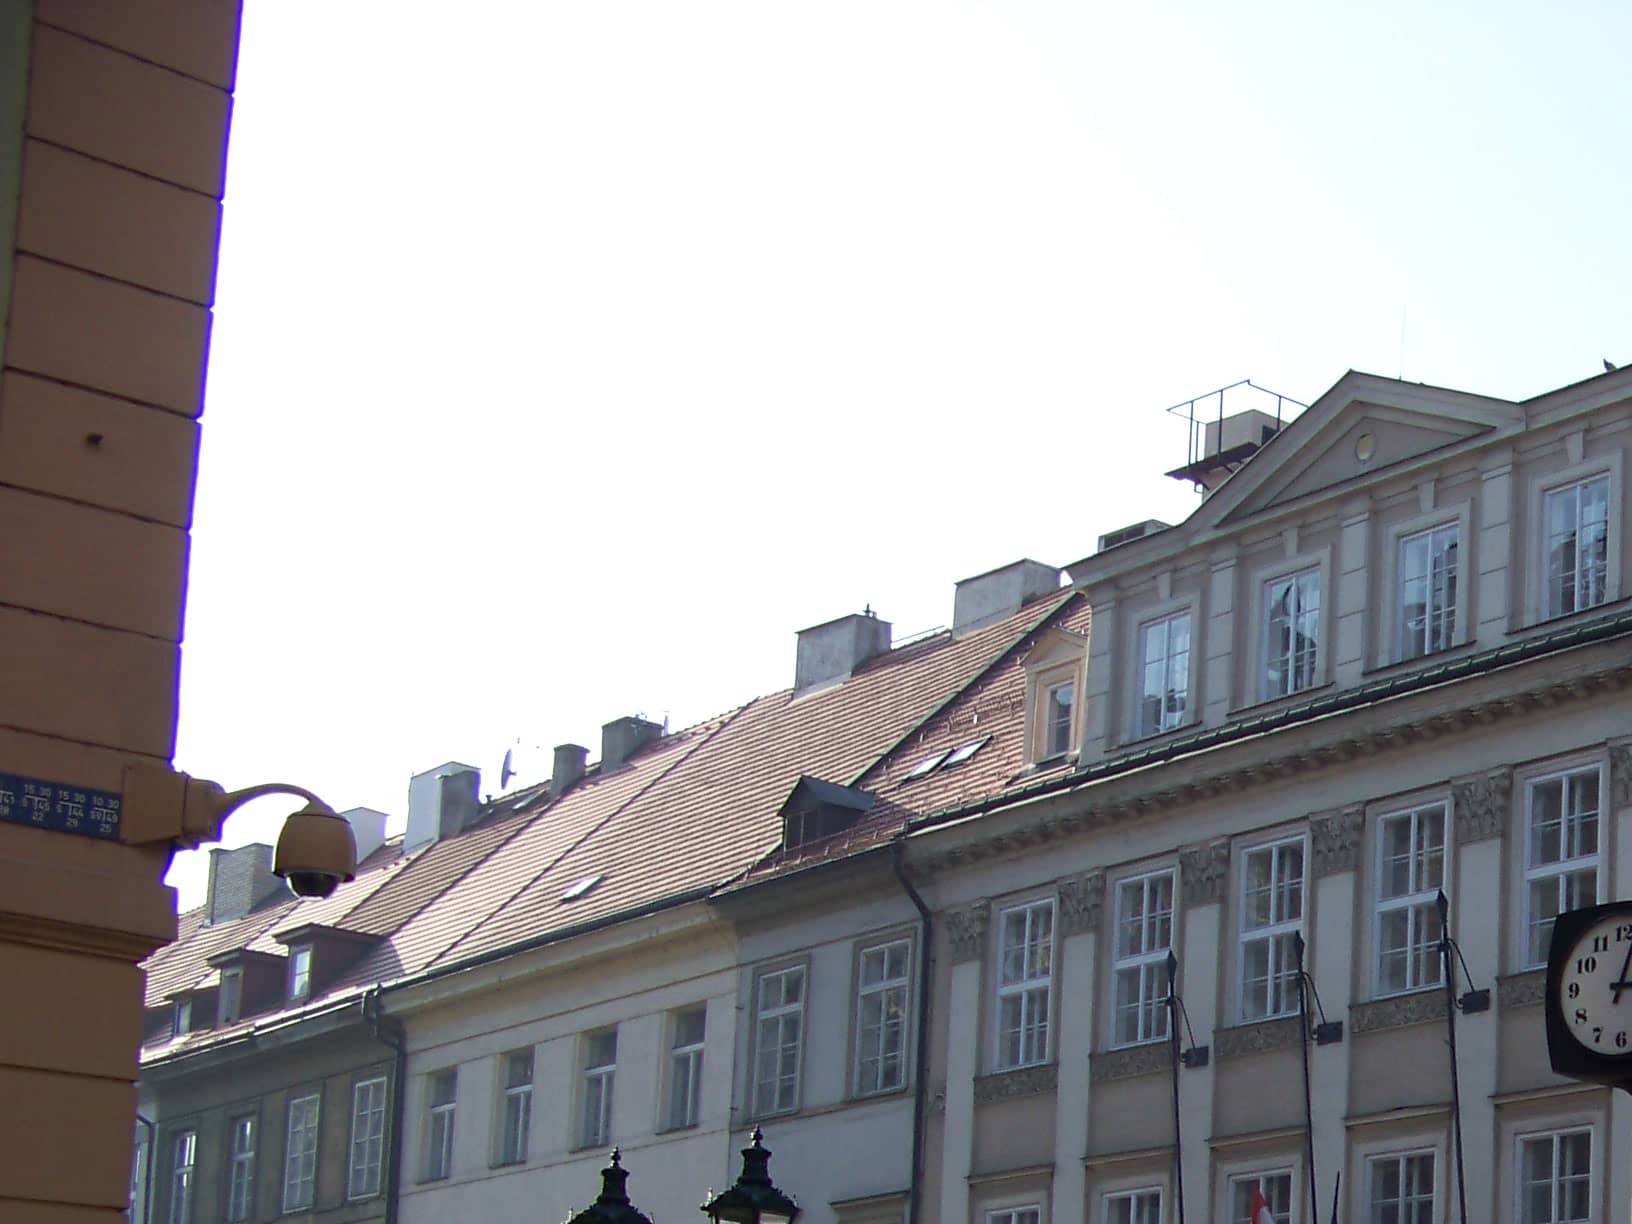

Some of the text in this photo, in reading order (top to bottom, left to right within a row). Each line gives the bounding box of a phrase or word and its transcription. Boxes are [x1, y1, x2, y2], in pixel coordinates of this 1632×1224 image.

[1593, 936, 1609, 953] 11
[1576, 956, 1597, 974] 10
[1568, 982, 1580, 999] 9
[1575, 1008, 1588, 1025] 8
[1592, 1027, 1604, 1043] 7
[1615, 1031, 1628, 1048] 6
